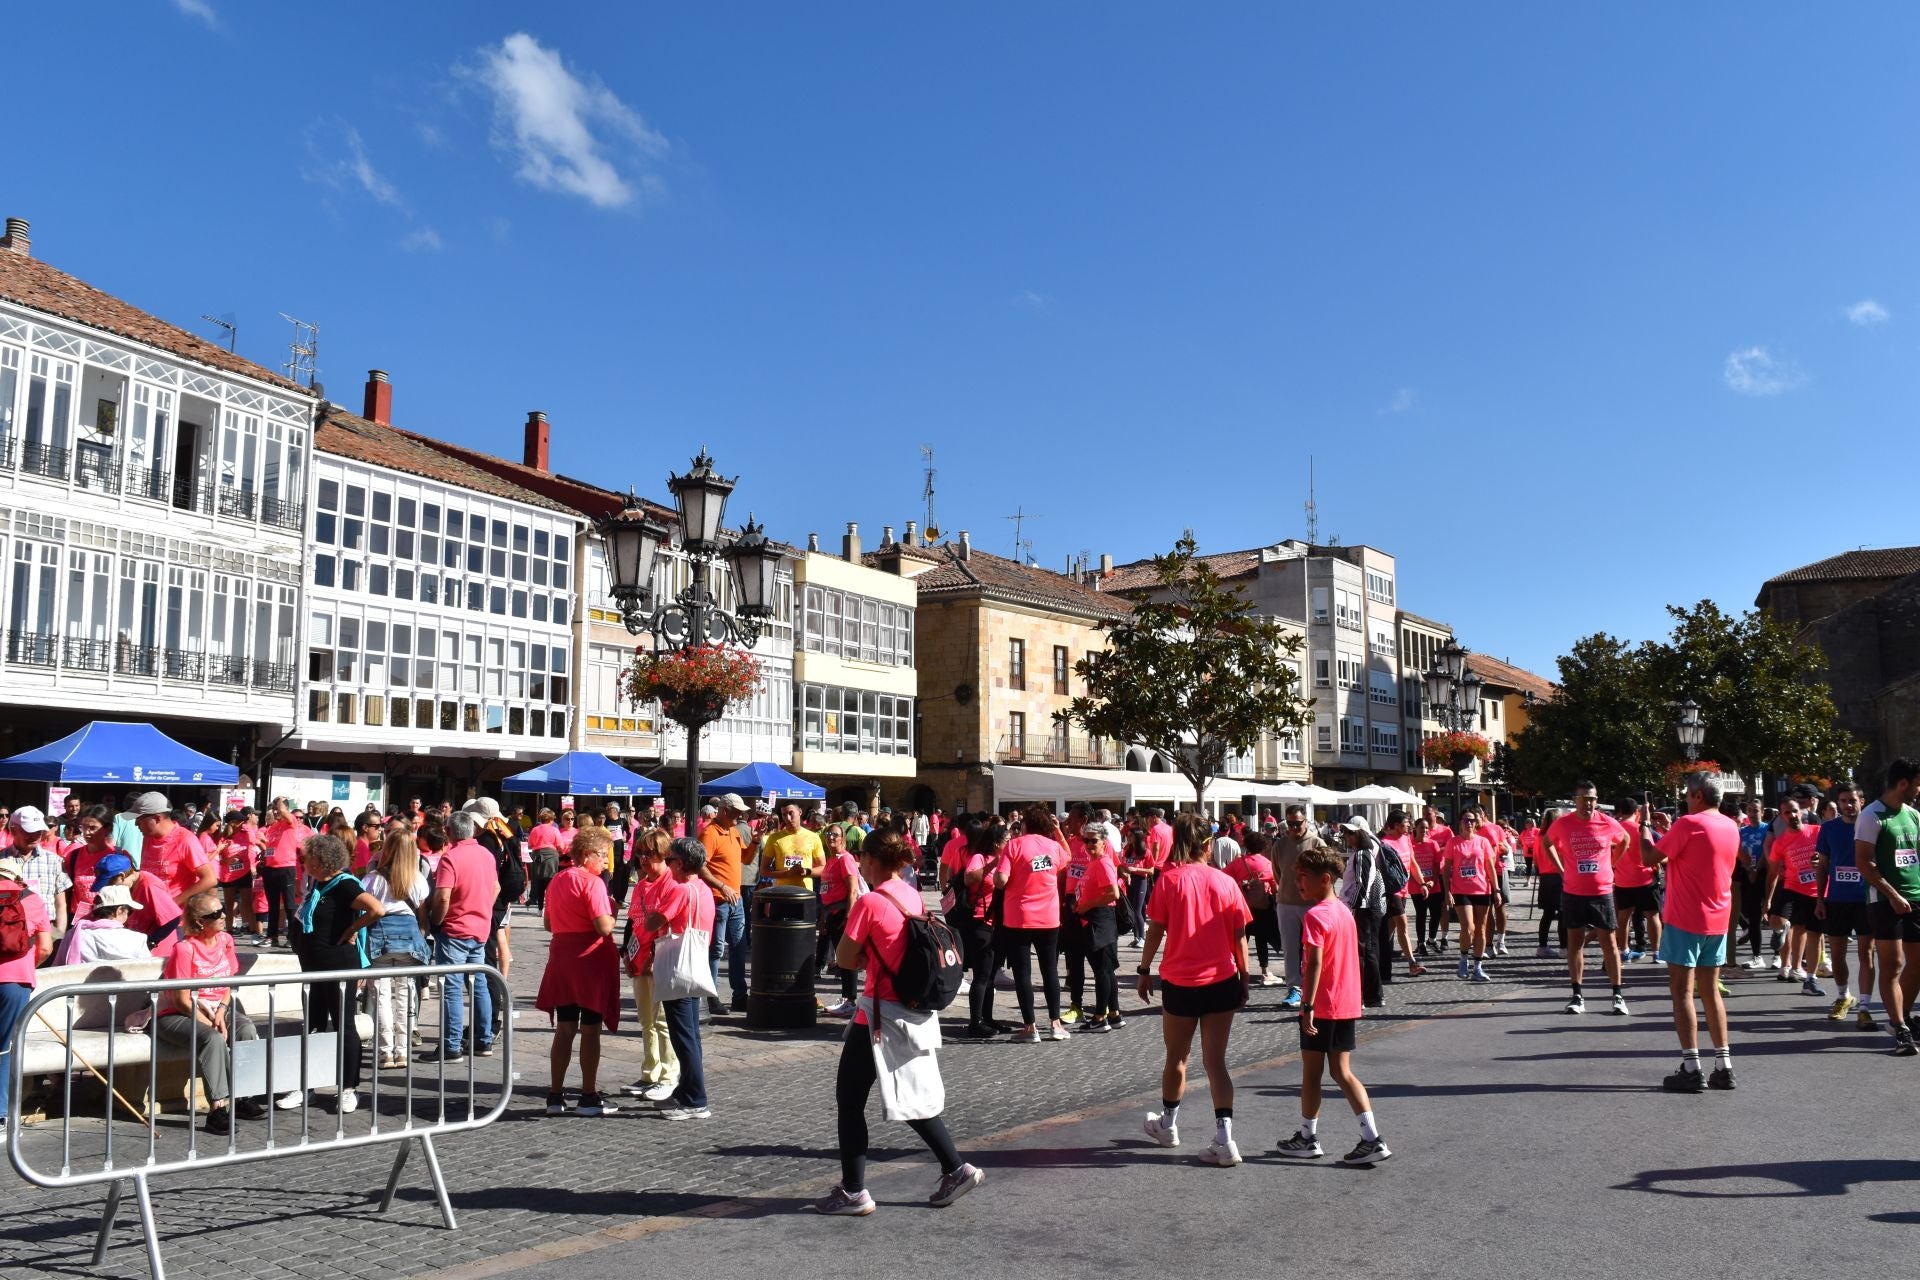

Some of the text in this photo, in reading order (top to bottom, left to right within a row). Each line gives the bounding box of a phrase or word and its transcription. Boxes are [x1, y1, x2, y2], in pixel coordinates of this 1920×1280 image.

[785, 859, 802, 867] 644
[1034, 860, 1052, 870] 234
[1897, 855, 1917, 865] 683
[1838, 871, 1859, 881] 695
